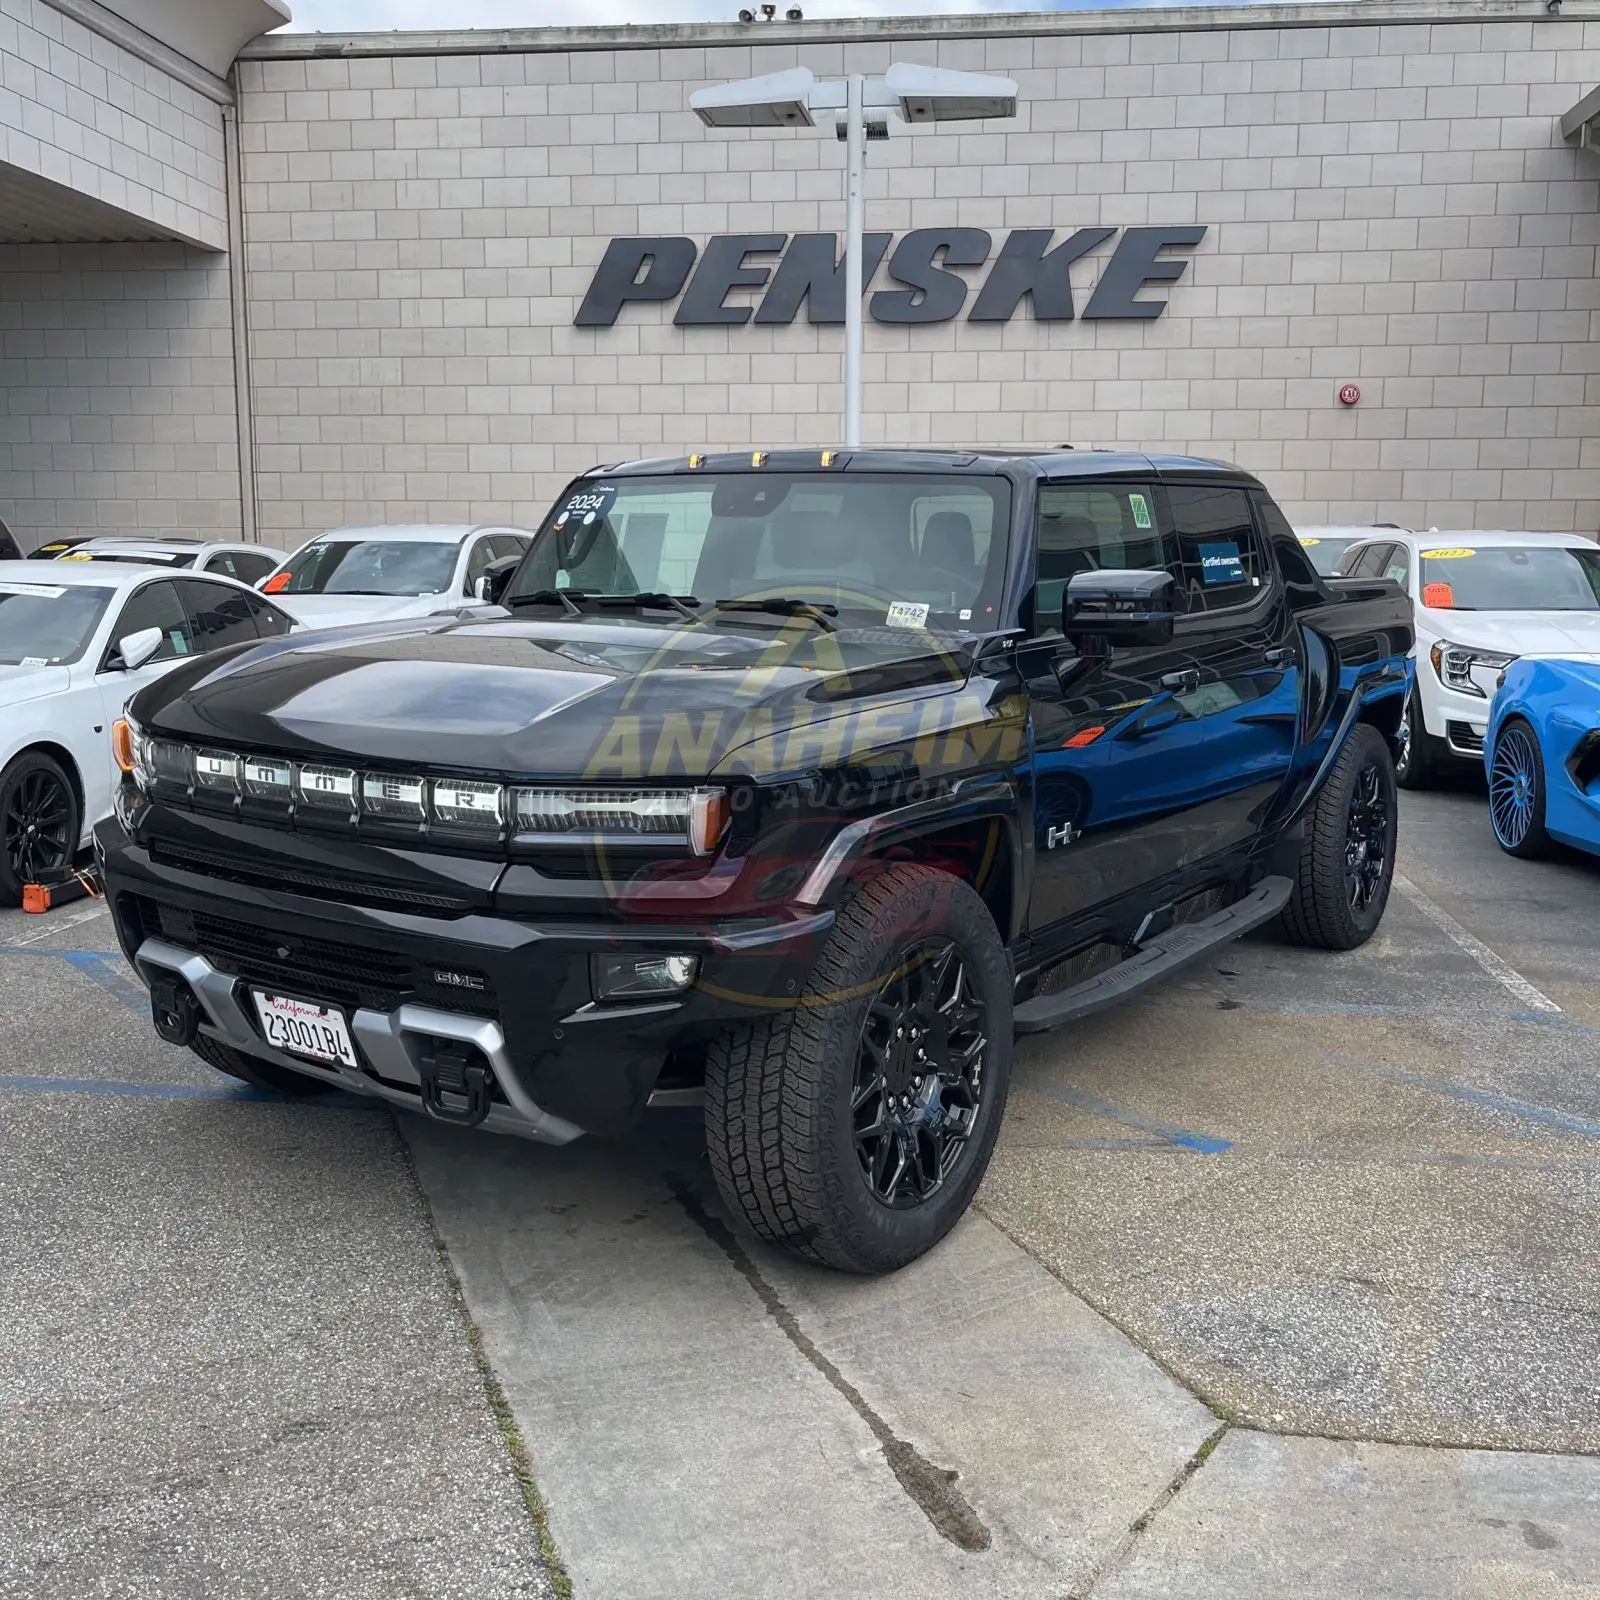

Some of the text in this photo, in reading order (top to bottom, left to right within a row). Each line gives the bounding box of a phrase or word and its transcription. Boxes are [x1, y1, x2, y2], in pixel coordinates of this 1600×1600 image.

[573, 225, 1208, 326] PENSKE
[566, 494, 606, 510] 2024
[891, 605, 925, 619] T4742
[435, 971, 485, 990] GMC
[271, 995, 331, 1022] California
[264, 1011, 350, 1060] 23001B4
